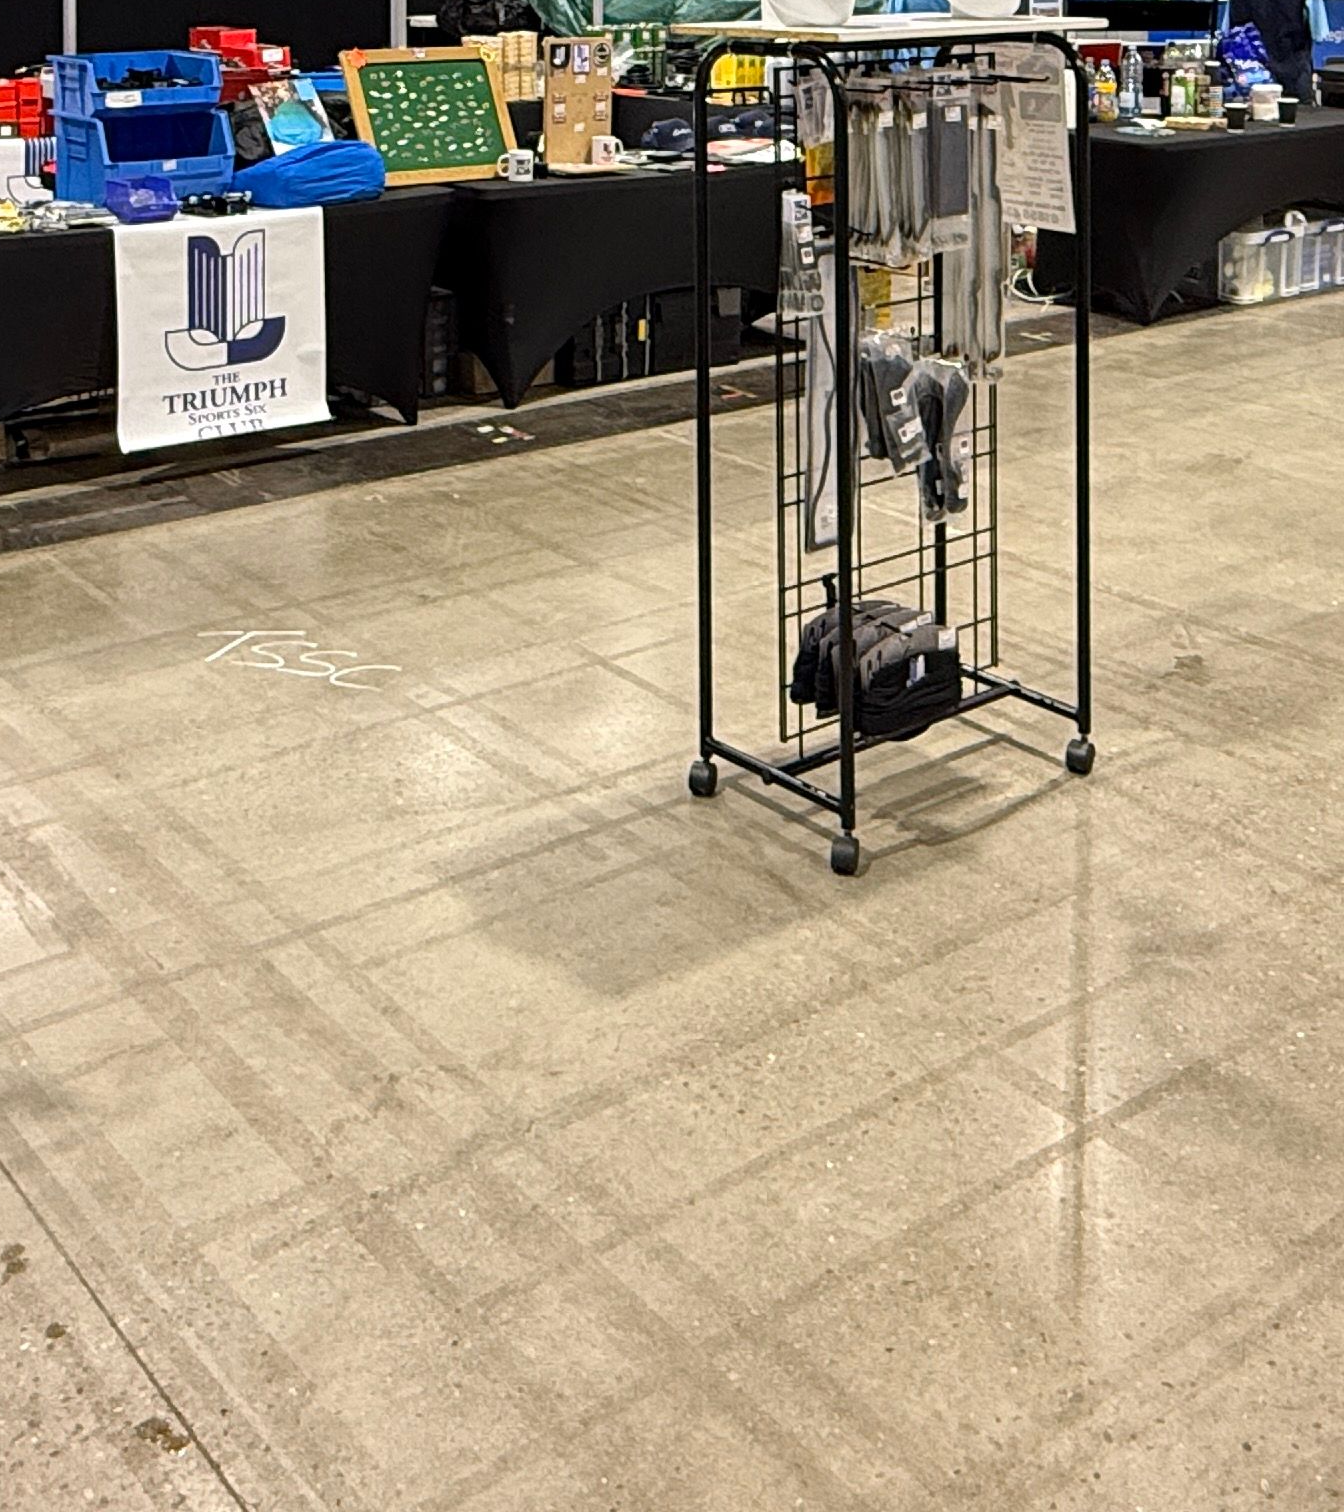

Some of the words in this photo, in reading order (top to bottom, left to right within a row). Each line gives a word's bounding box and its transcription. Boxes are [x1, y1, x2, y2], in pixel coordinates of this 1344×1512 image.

[162, 378, 288, 415] TRIUMPH
[212, 371, 241, 386] THE
[197, 630, 403, 692] TSSC
